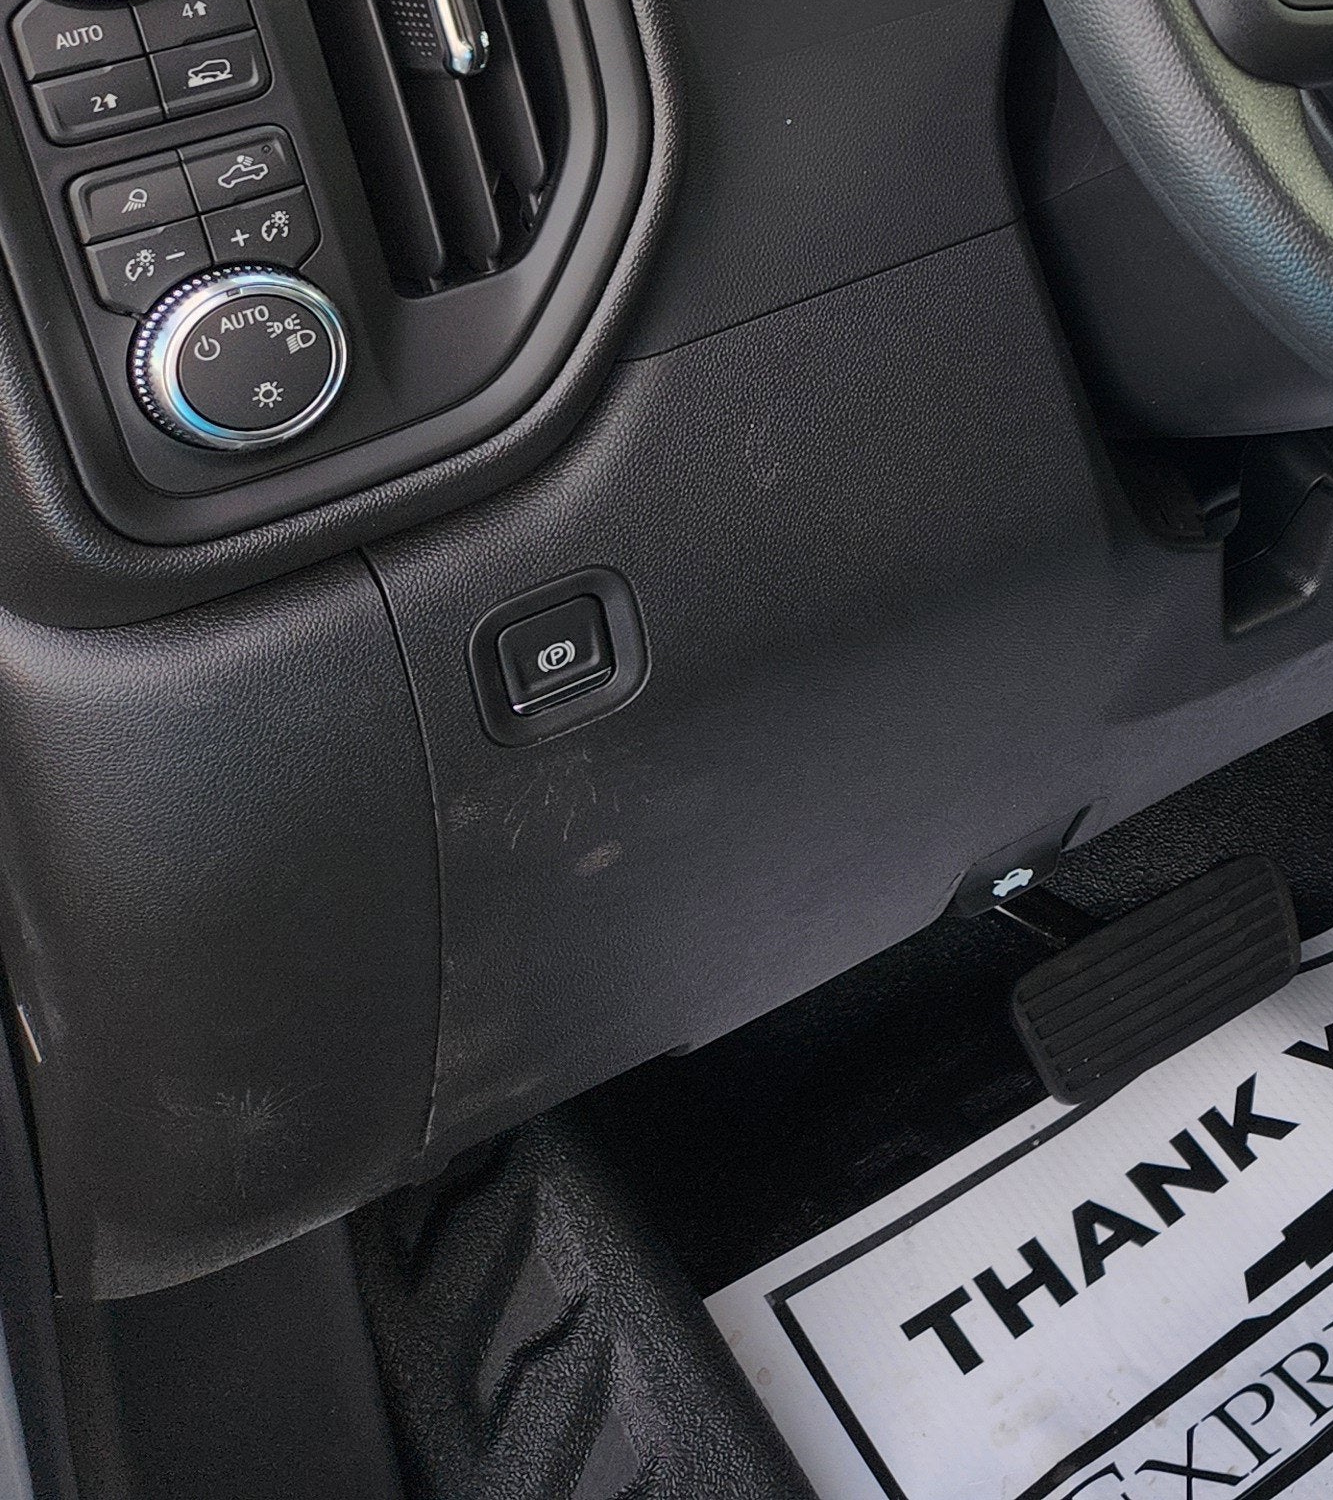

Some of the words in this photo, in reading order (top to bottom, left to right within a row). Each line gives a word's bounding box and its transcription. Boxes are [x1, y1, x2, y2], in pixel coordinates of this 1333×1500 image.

[182, 3, 193, 18] 4
[56, 24, 103, 50] AUTO
[90, 96, 104, 113] 2
[219, 304, 269, 333] AUTO
[900, 1072, 1300, 1375] THANK
